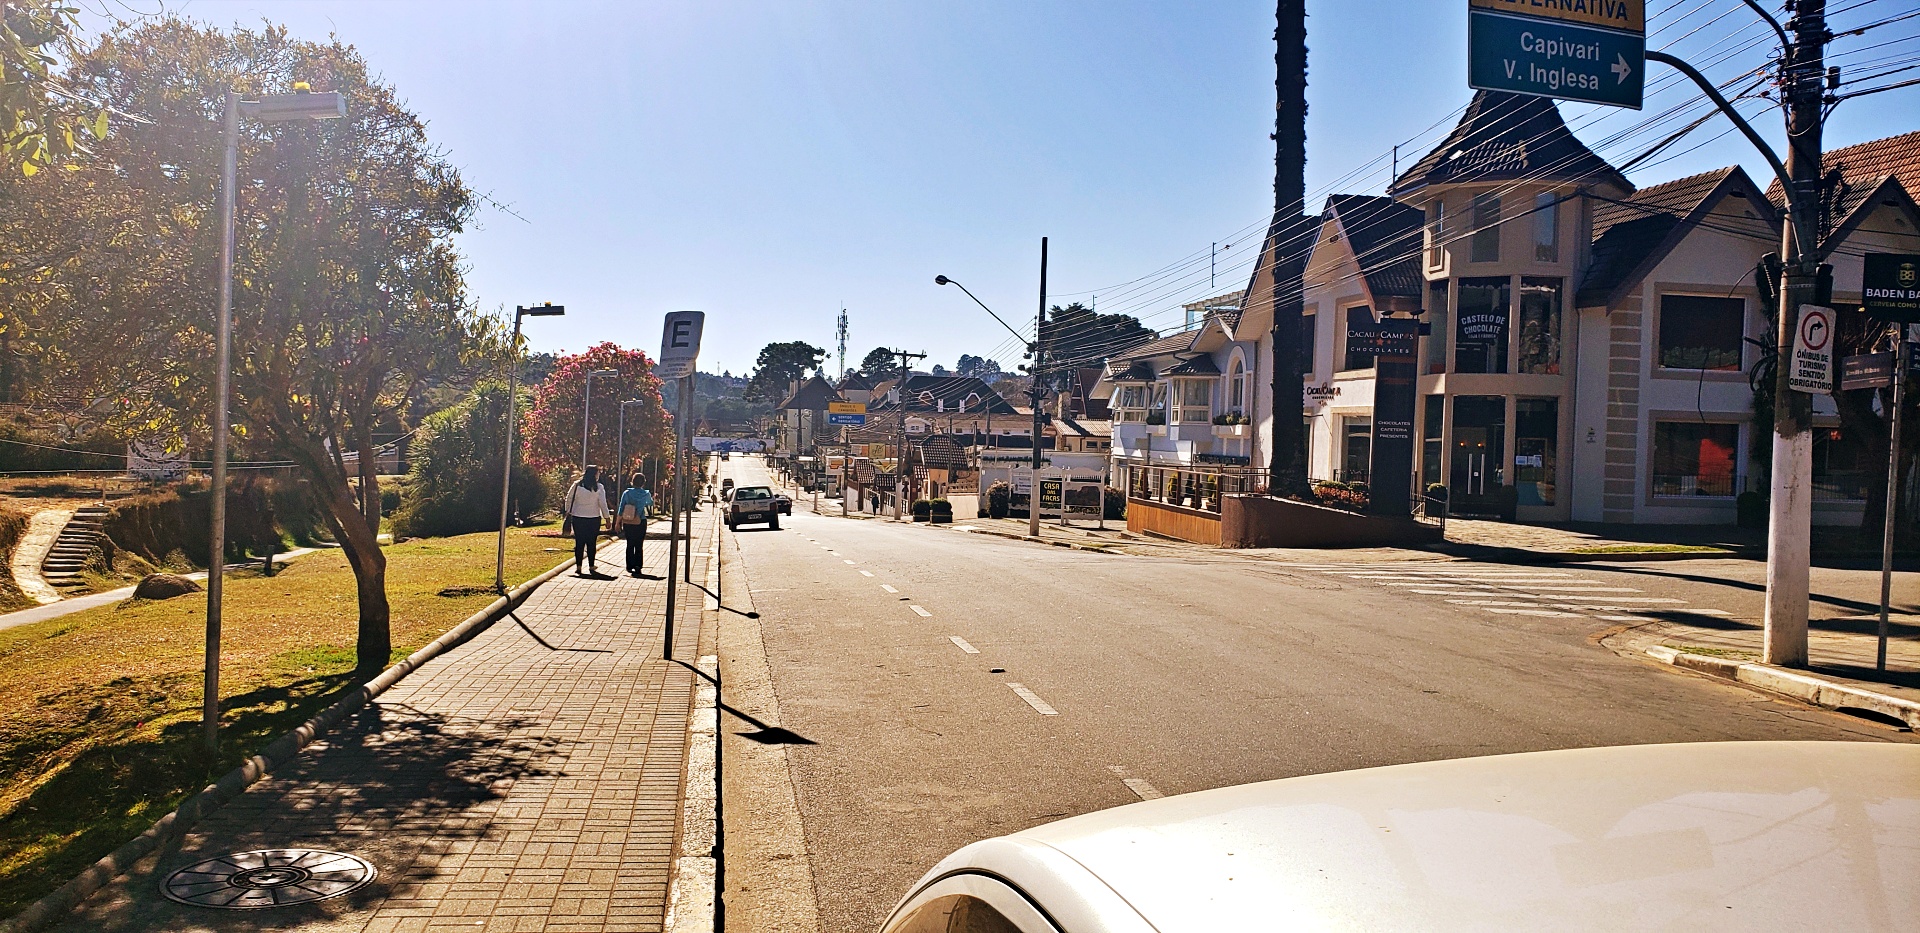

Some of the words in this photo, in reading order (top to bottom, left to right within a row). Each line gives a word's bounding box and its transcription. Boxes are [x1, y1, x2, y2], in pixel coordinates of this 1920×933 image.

[1499, 0, 1628, 21] NATIVA
[1520, 32, 1600, 61] Capivari
[1503, 59, 1522, 80] V.
[1530, 62, 1599, 90] Inglesa
[1866, 288, 1905, 299] BADEN
[1461, 314, 1494, 325] CASTELO
[1495, 315, 1506, 325] DE
[671, 320, 692, 348] E
[1347, 330, 1375, 338] CACAU
[1464, 324, 1501, 334] CHOCOLATE
[1350, 346, 1410, 354] CHOCOLATES
[1796, 348, 1820, 361] ÔNIBUS
[1820, 354, 1829, 362] DE
[1798, 359, 1827, 371] TURISMO
[1798, 369, 1826, 380] SENTIDO
[1789, 377, 1832, 390] OBRIGATÓRIO
[1043, 482, 1060, 490] CASA
